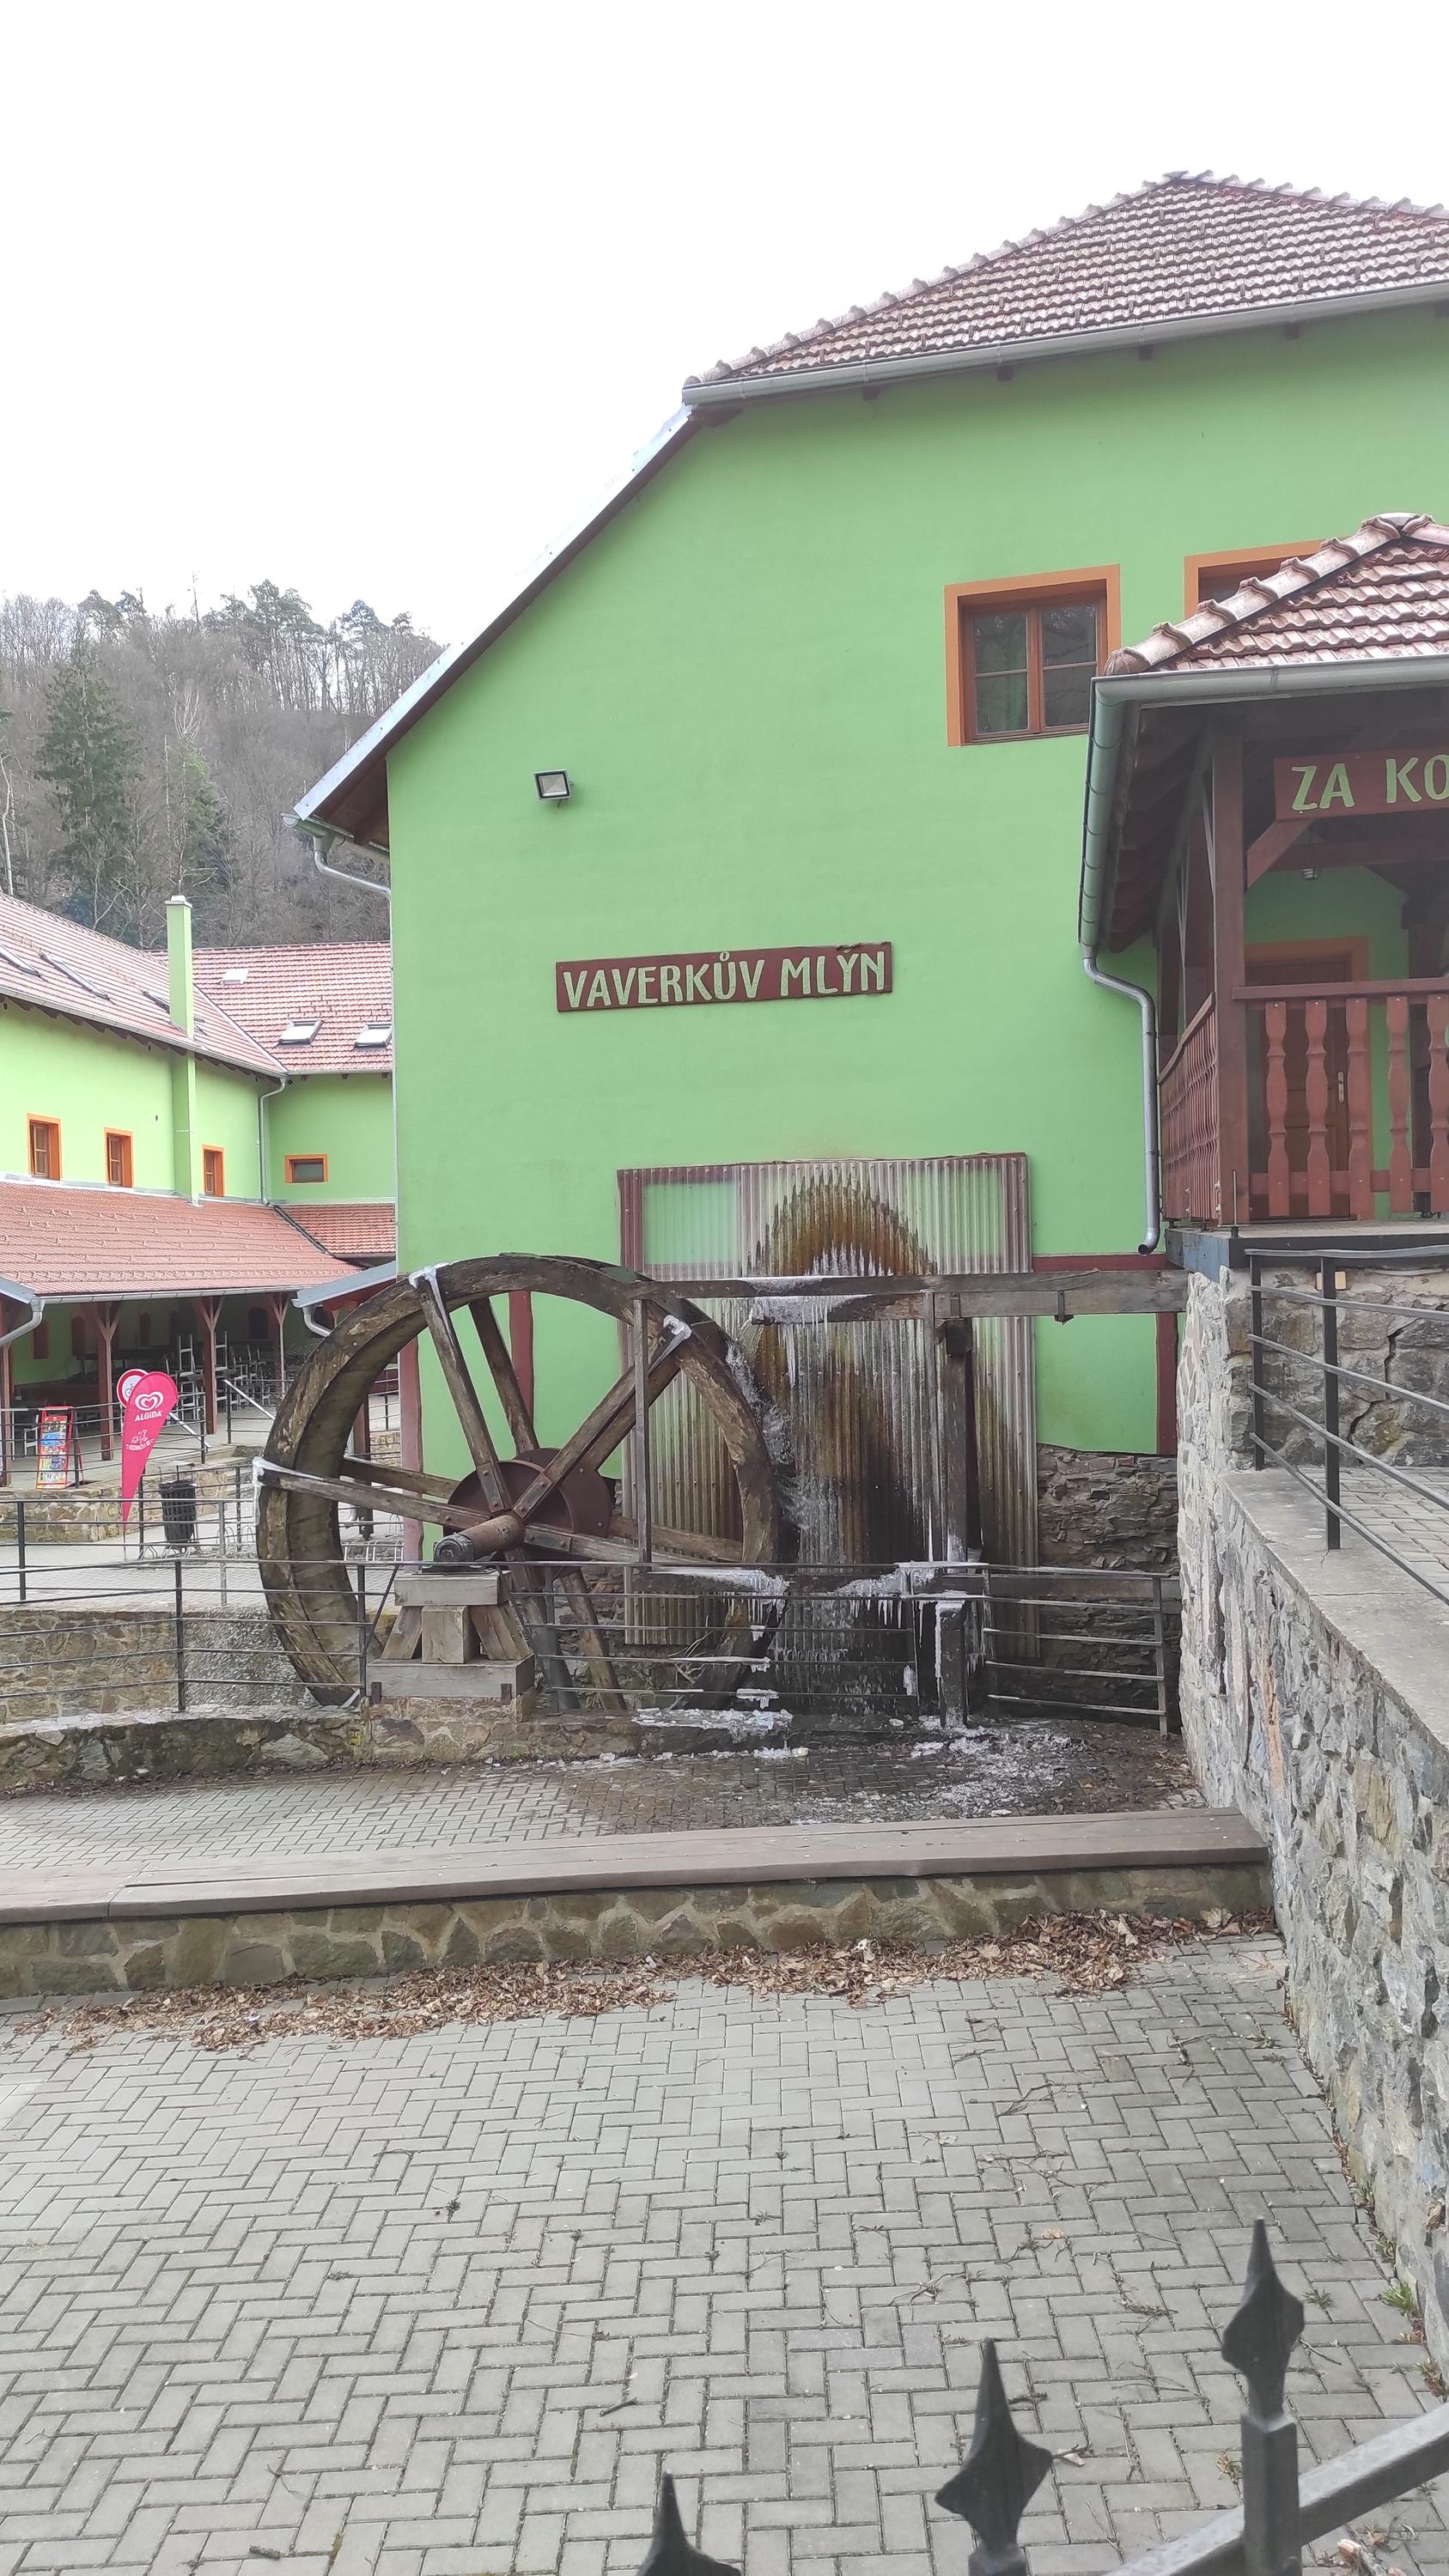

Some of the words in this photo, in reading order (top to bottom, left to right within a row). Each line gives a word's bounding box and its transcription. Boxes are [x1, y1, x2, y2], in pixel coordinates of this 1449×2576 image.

[1291, 762, 1355, 811] ZA
[563, 951, 764, 1008] VAVERKŮV
[780, 948, 885, 996] MLÝN
[134, 1410, 162, 1422] ALGIDA
